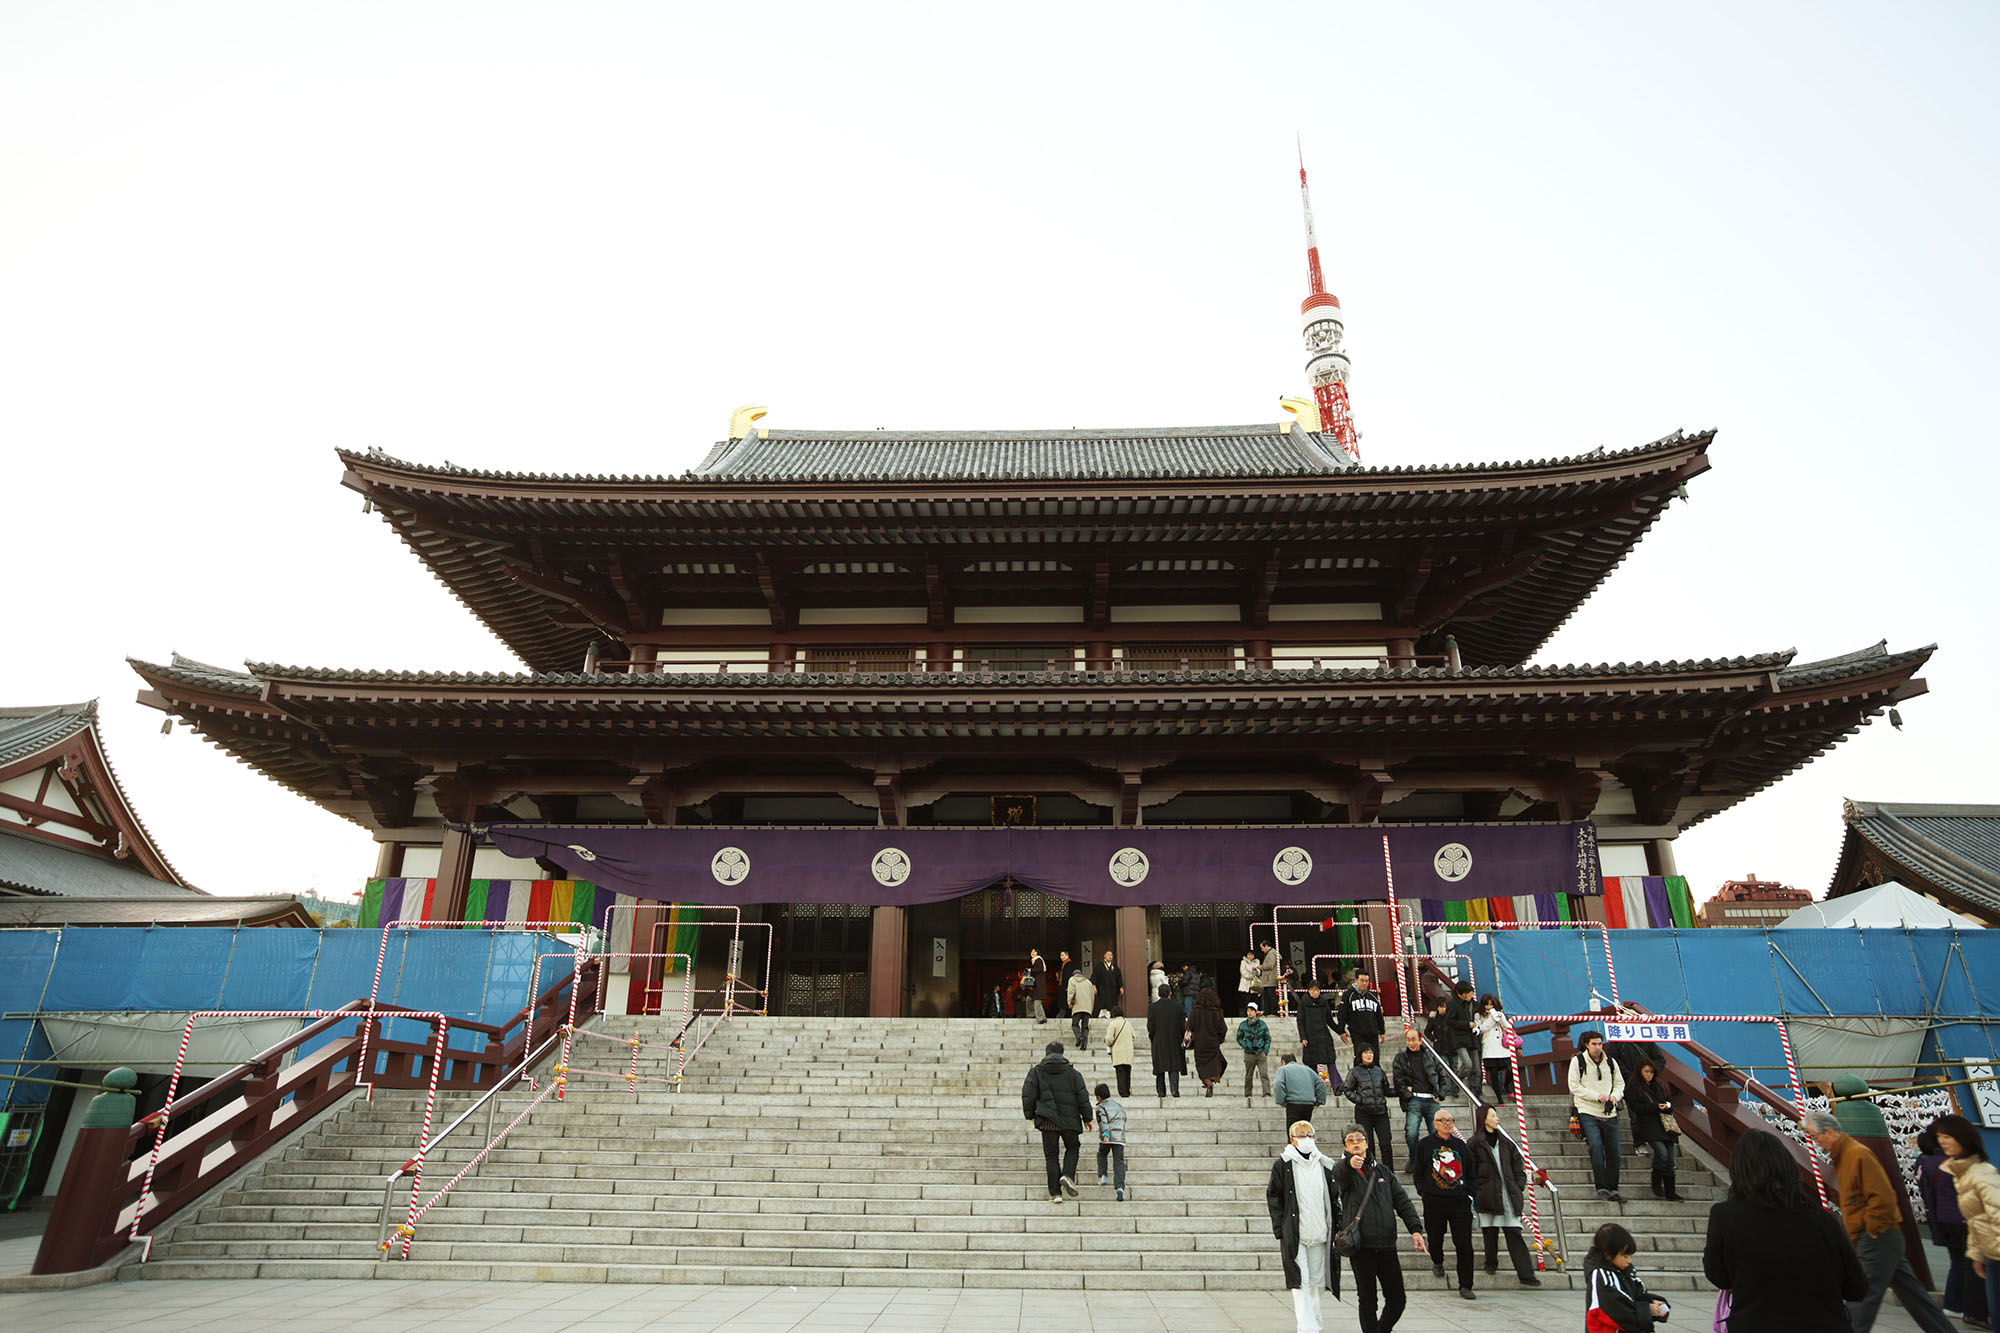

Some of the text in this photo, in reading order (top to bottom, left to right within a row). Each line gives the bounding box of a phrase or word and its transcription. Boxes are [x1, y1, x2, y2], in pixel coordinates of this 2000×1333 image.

[1576, 827, 1588, 894] 大本山増上寺
[936, 941, 945, 962] 入口
[1083, 945, 1091, 968] 入口
[1293, 944, 1303, 966] 入口
[1607, 1025, 1687, 1040] 降り口専用
